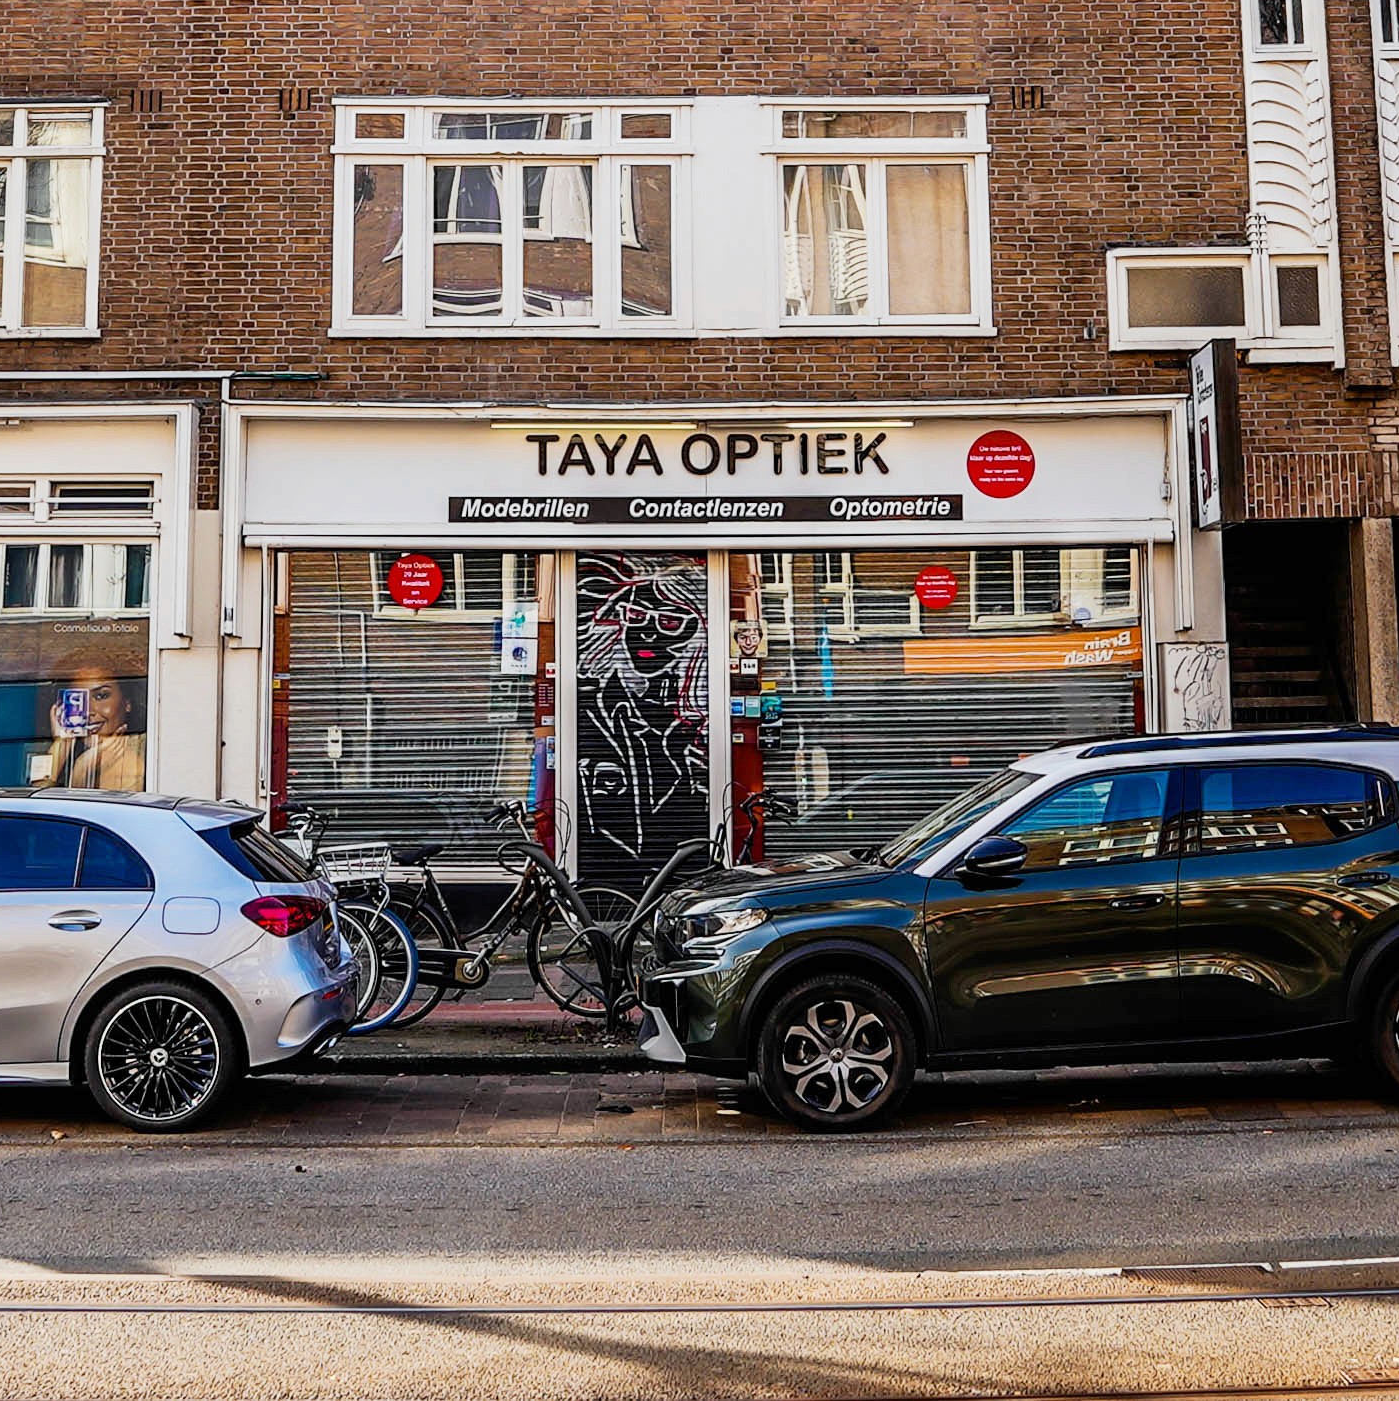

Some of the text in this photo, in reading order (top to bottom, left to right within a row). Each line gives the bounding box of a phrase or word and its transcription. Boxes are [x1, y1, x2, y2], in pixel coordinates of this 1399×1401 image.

[525, 432, 890, 476] TAYA OPTIEK
[461, 496, 951, 521] Modebrillen Contactlenzen Optometrie
[112, 623, 140, 633] Totale
